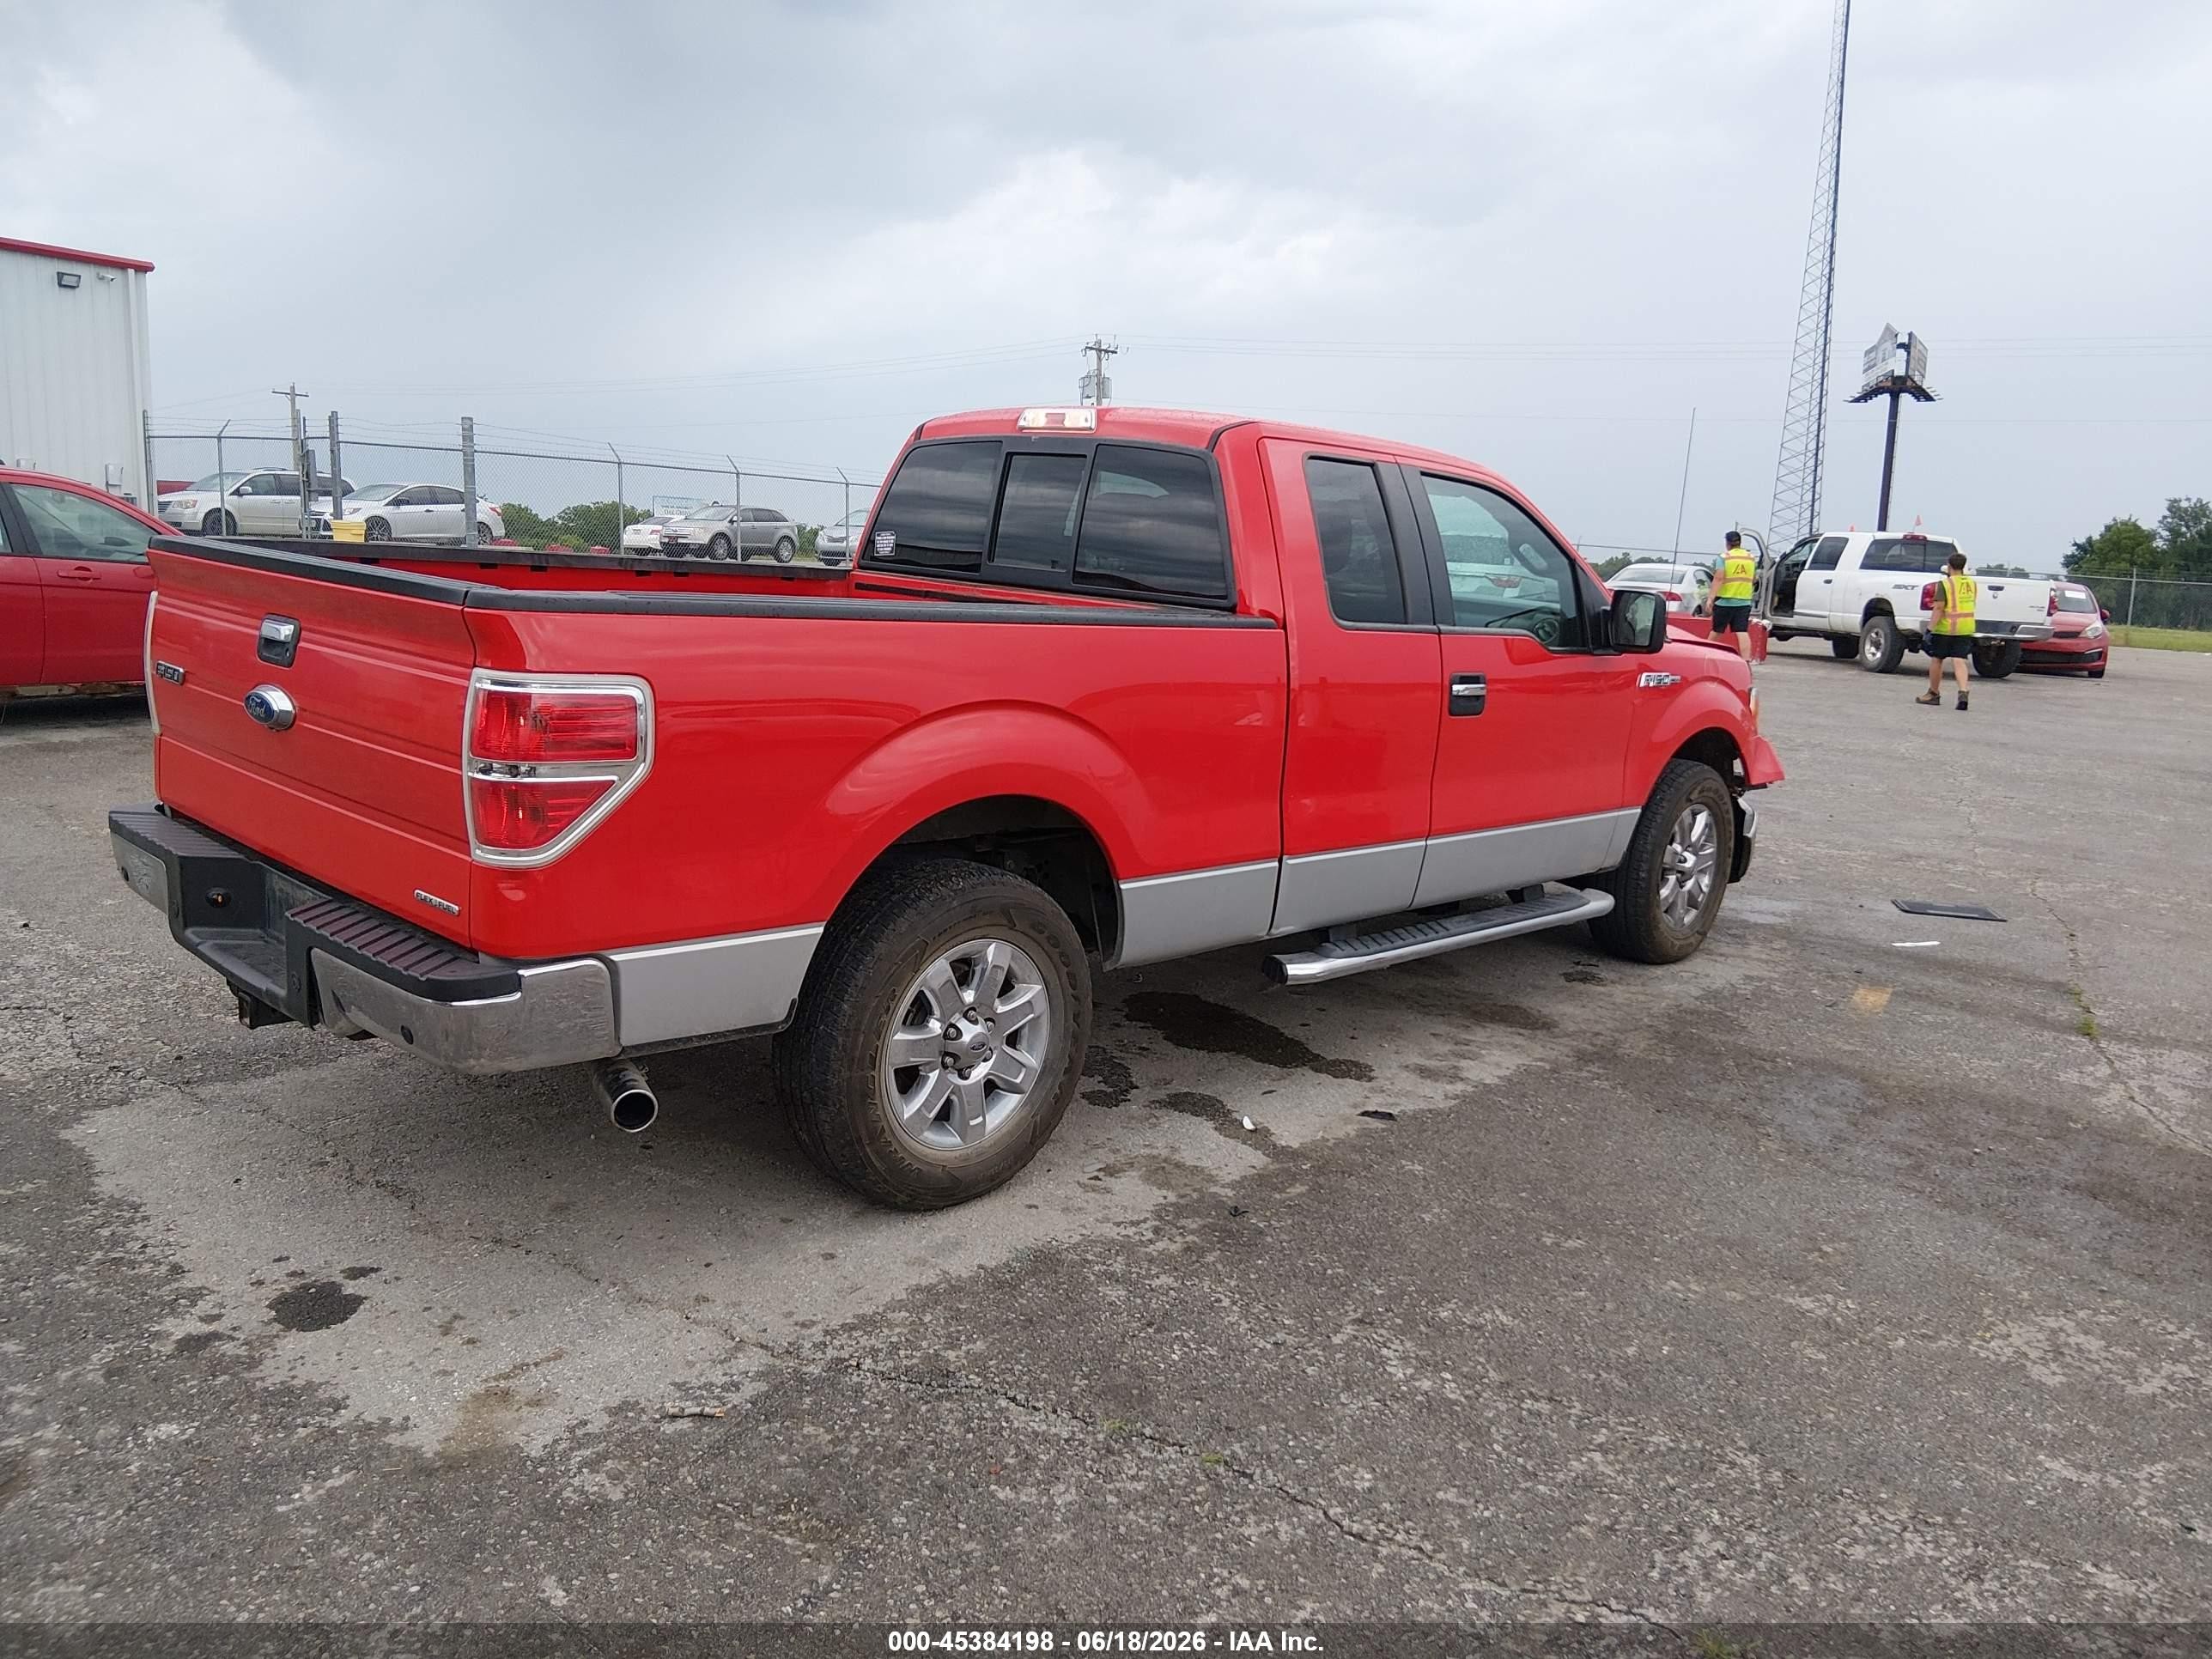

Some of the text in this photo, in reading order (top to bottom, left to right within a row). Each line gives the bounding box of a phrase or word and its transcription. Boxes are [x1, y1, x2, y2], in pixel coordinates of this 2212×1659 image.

[247, 696, 266, 718] Ford
[416, 891, 457, 915] FLEX FUEL
